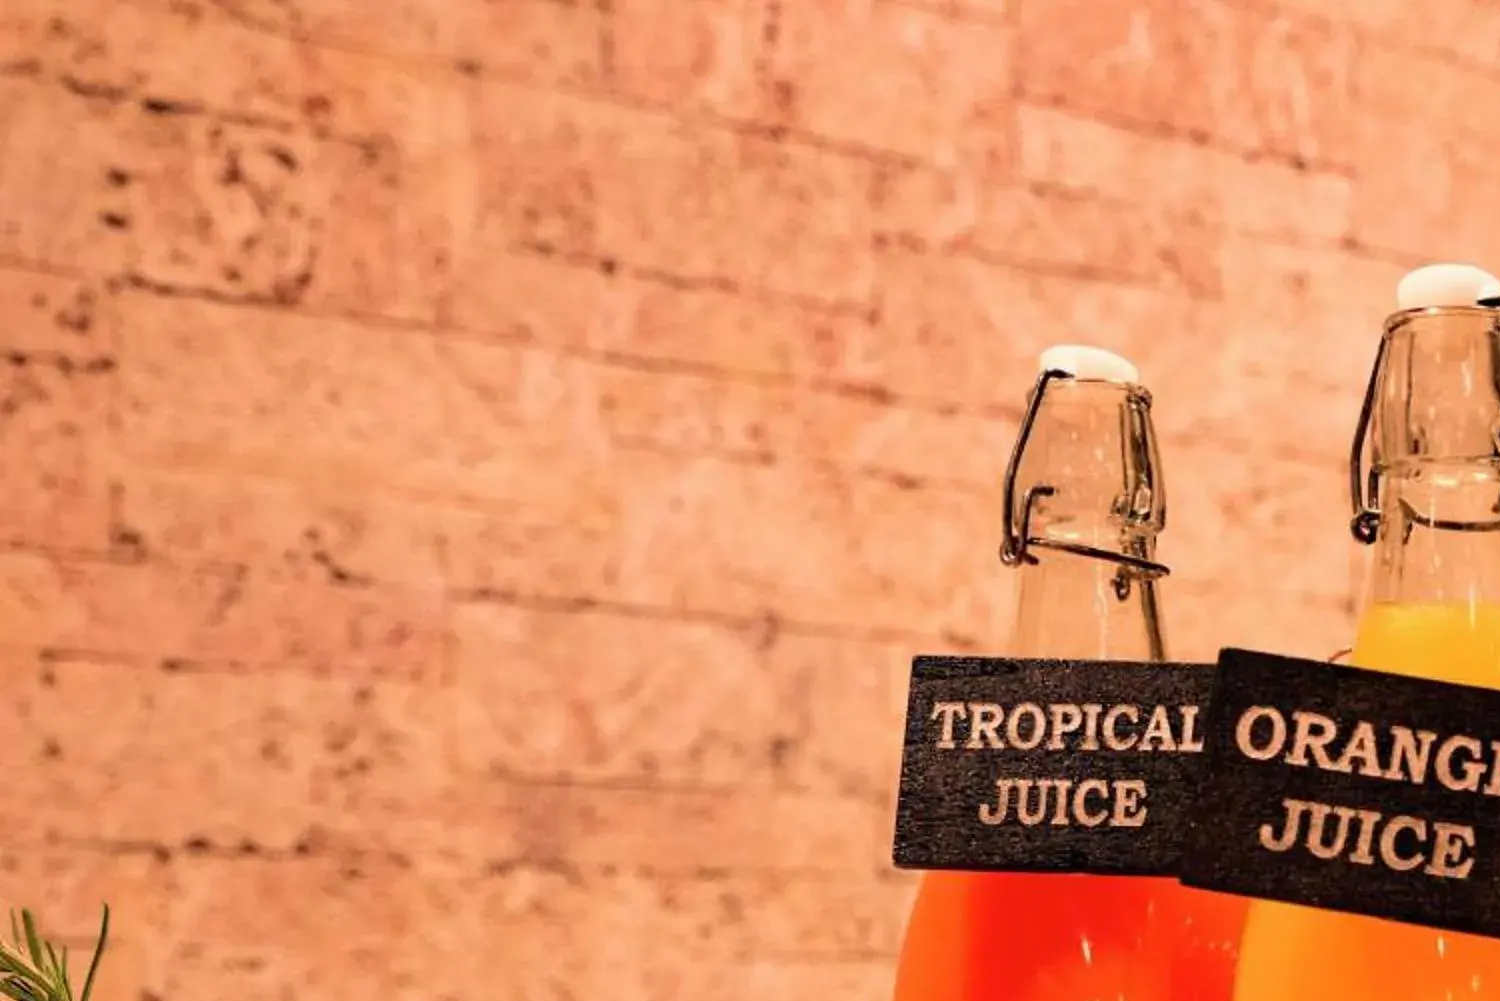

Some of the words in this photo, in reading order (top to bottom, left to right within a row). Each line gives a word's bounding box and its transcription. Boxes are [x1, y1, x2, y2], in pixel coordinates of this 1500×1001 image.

[931, 701, 1204, 752] TROPICAL
[978, 778, 1147, 828] JUICE
[1259, 798, 1476, 879] JUICE
